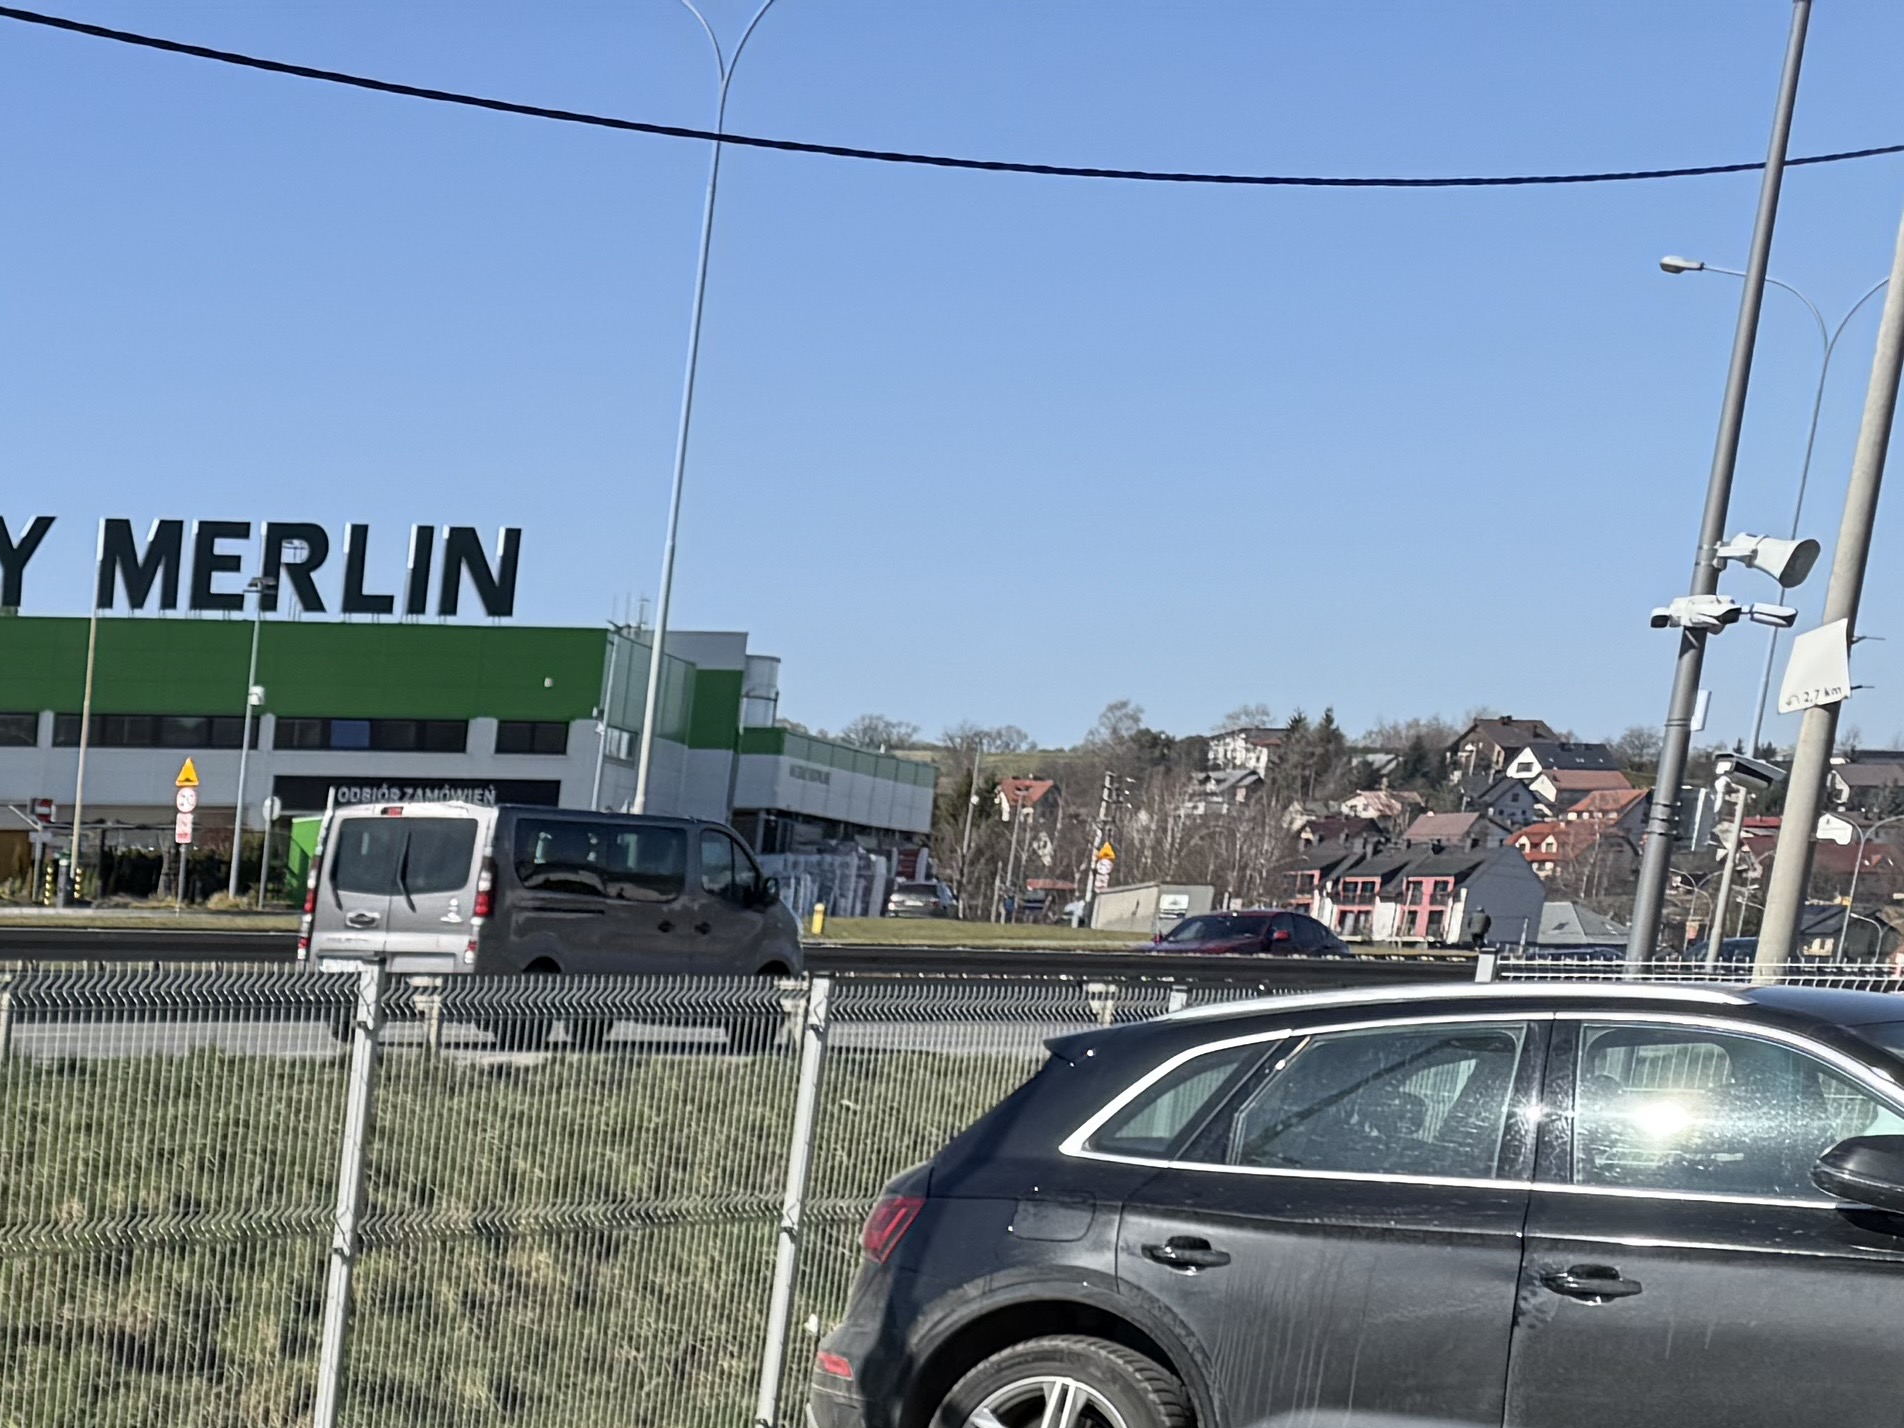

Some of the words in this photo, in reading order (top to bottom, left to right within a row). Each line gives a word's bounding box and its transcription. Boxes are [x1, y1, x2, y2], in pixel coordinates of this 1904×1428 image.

[96, 517, 522, 618] MERLIN
[337, 782, 401, 803] ODBIÓR
[402, 783, 497, 806] ZAMÓWIEŃ
